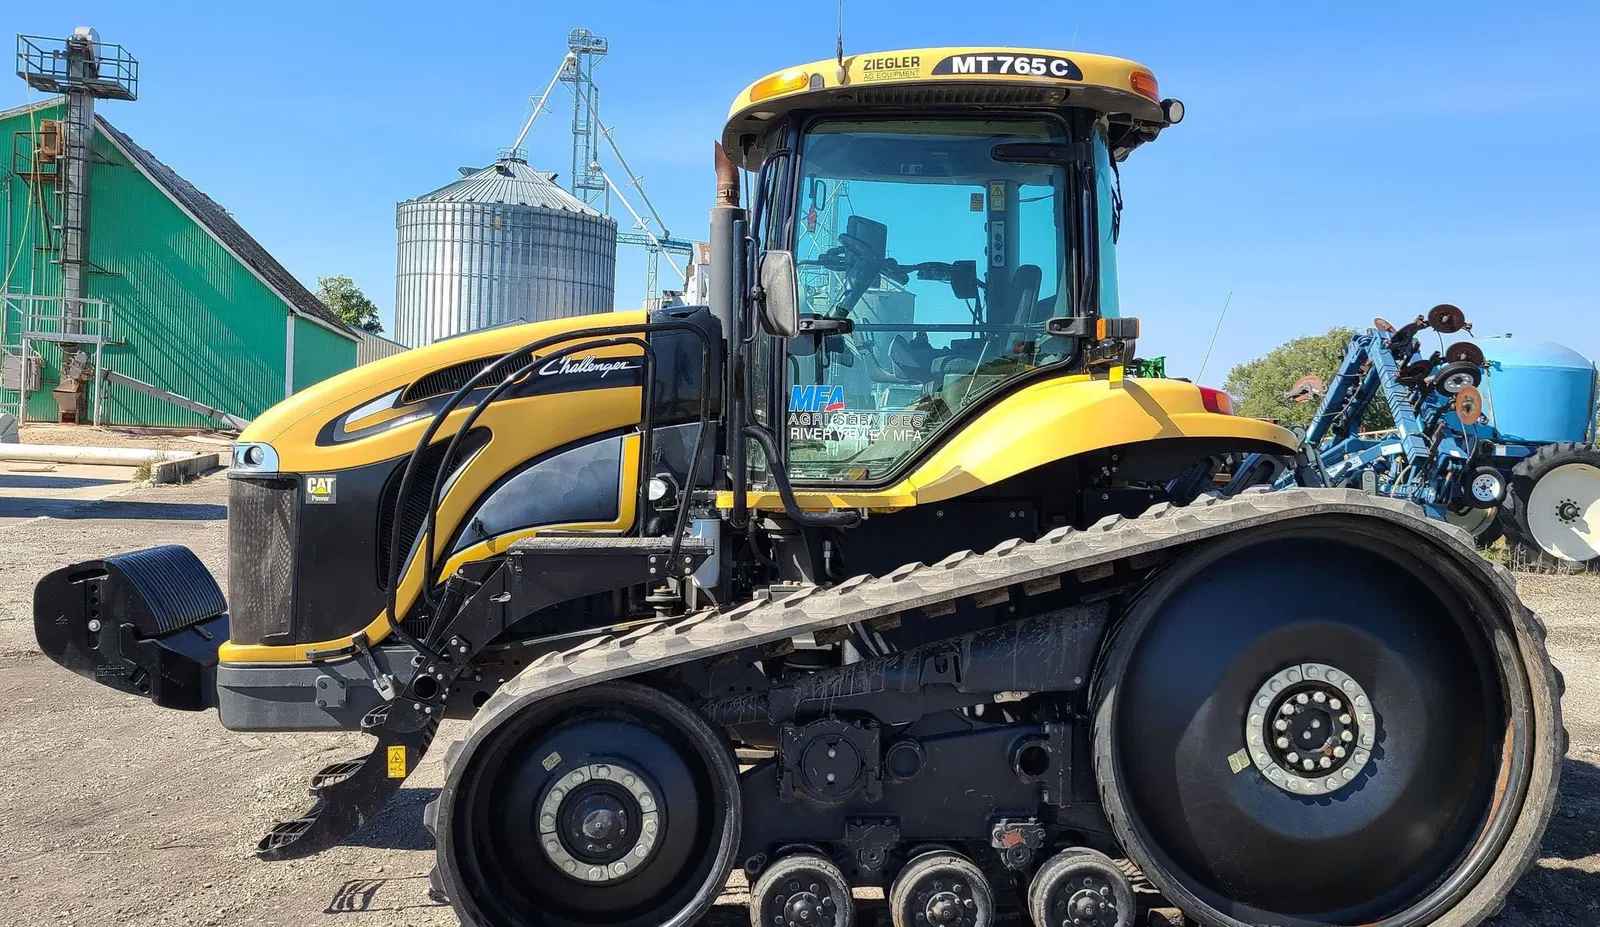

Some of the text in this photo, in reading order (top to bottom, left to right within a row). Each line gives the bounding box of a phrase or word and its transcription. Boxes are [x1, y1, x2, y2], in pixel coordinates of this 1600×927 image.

[863, 56, 920, 71] ZIEGLER
[876, 70, 920, 79] EQUIPMENT
[538, 355, 642, 378] Challenger
[789, 385, 846, 413] MFA
[788, 413, 925, 428] AGRI SERVICES
[790, 427, 832, 440] RIVER
[893, 429, 923, 442] MFA
[307, 477, 336, 494] CAT
